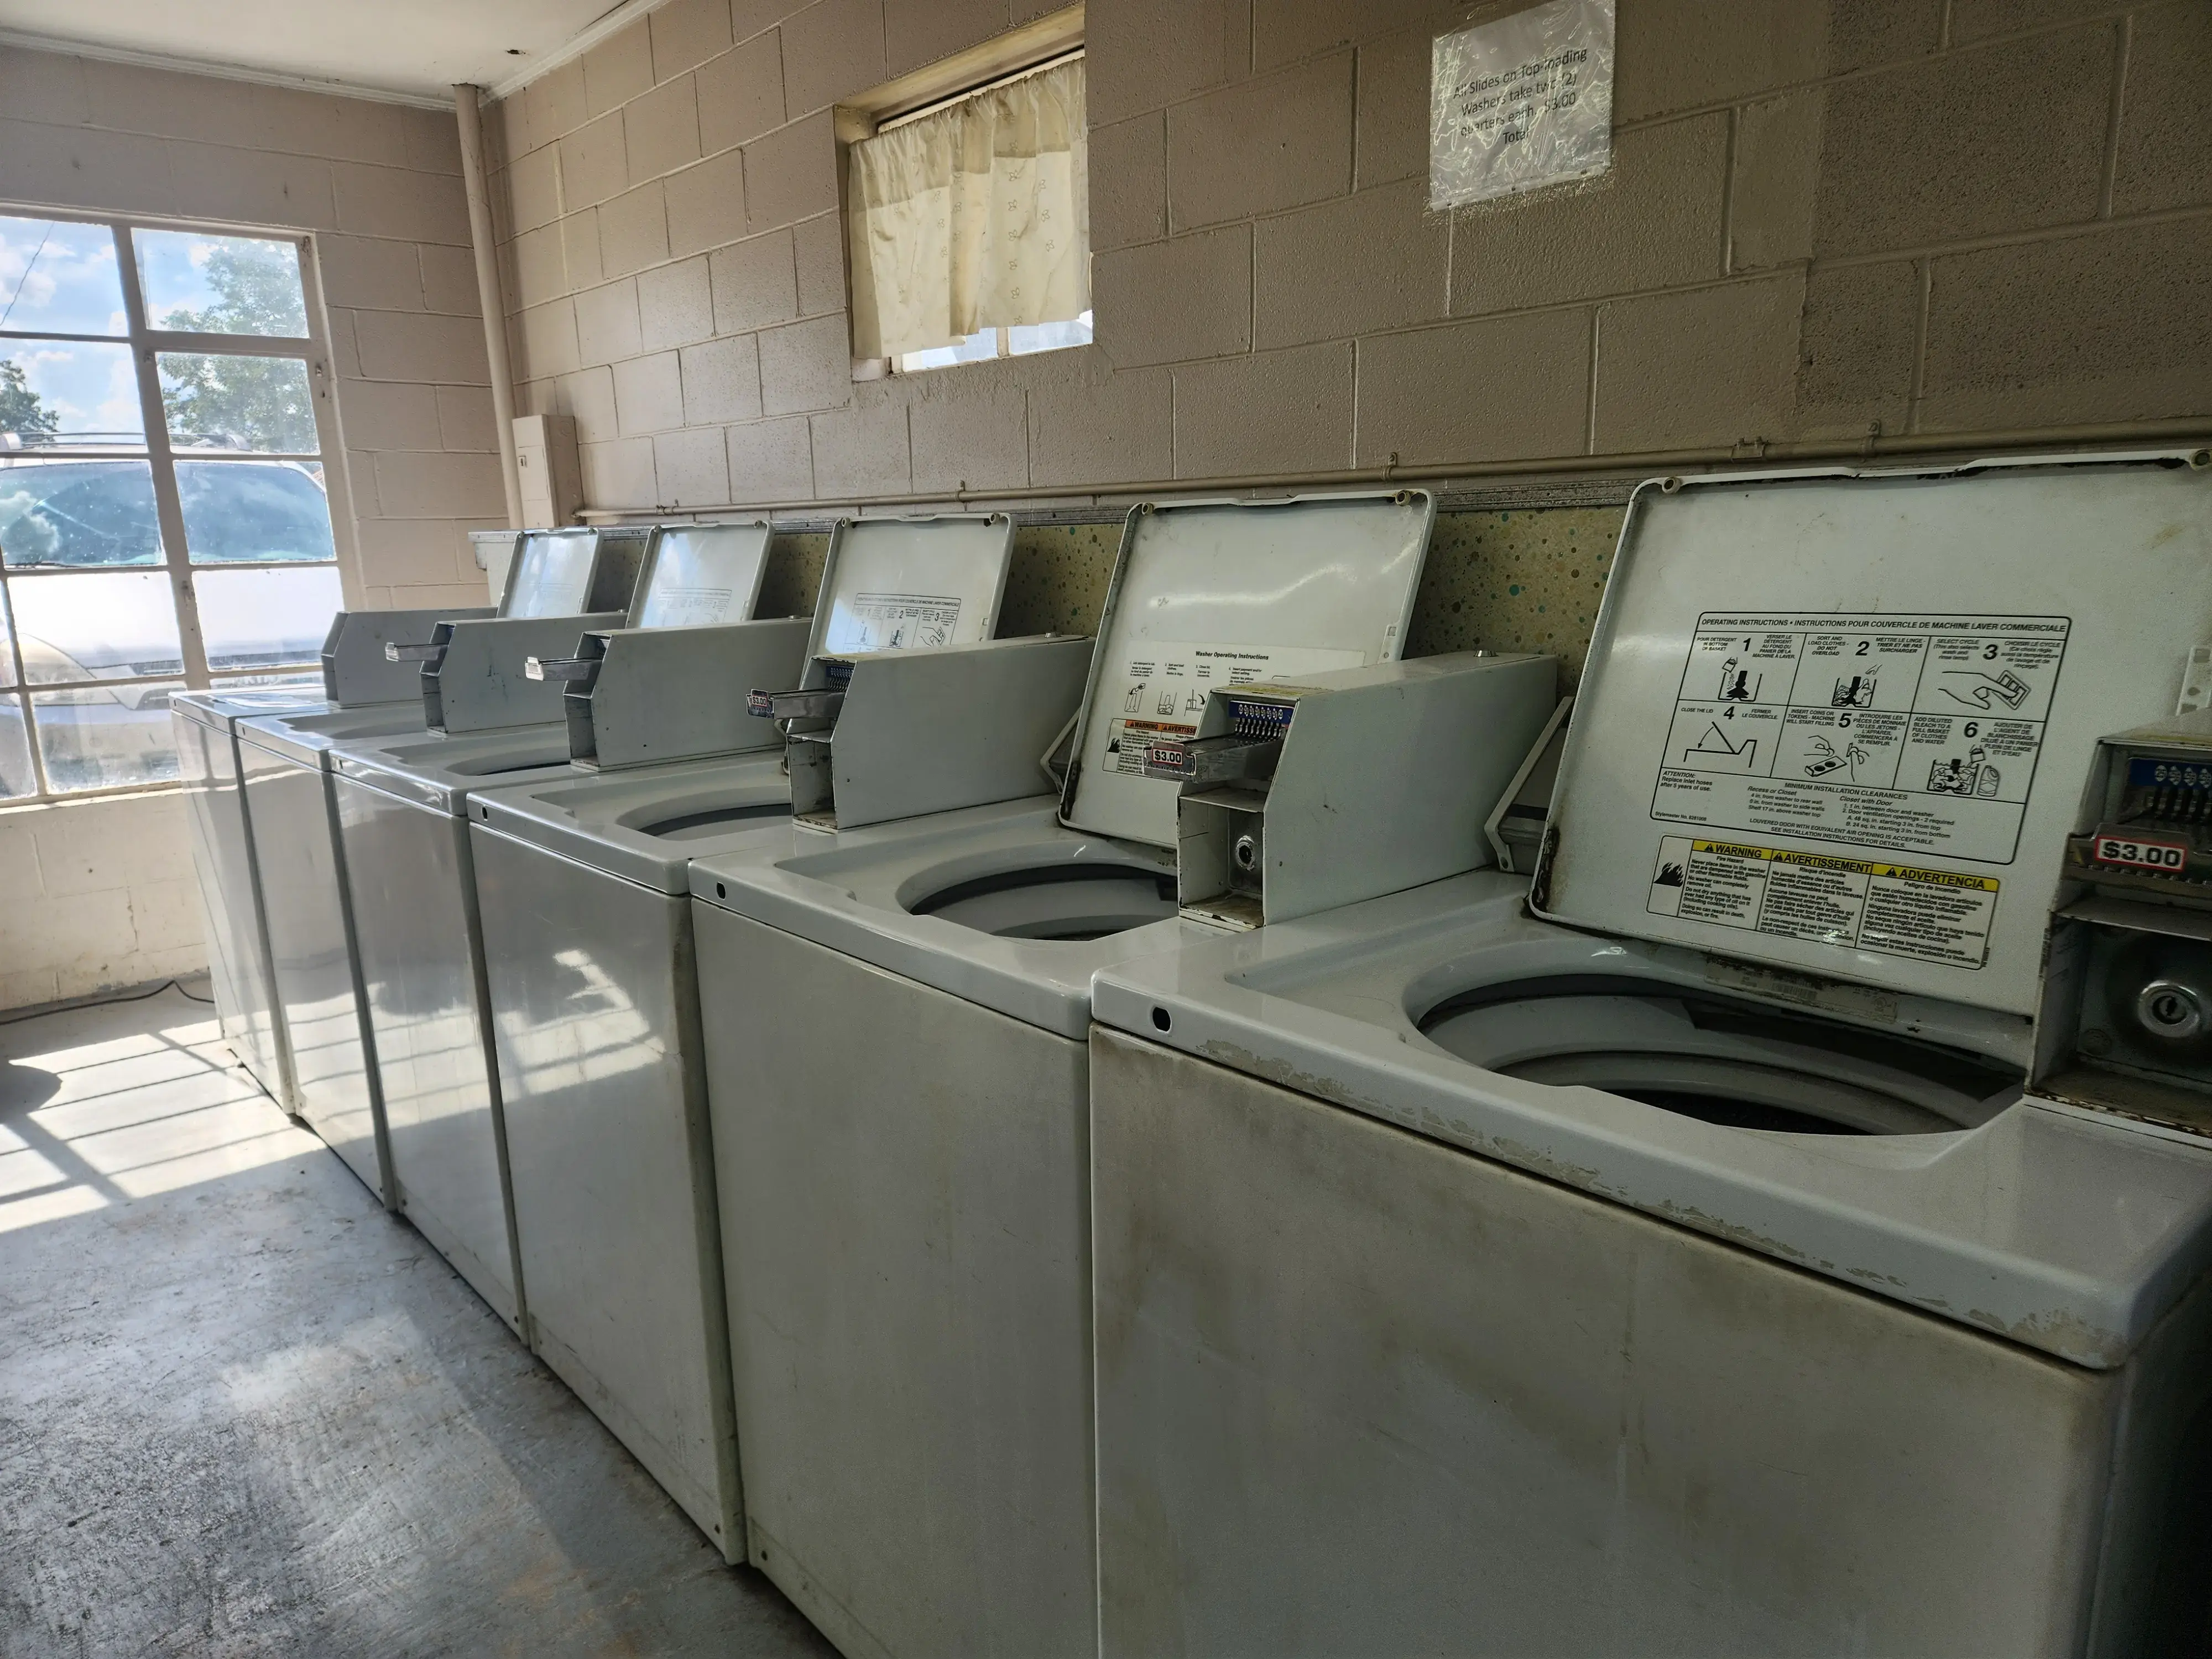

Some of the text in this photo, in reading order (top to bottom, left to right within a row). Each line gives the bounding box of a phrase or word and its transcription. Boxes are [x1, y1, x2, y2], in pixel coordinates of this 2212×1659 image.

[1469, 76, 1499, 94] Slides
[1503, 72, 1516, 83] on
[1521, 49, 1587, 78] Top-loading
[1462, 96, 1506, 116] Washers
[1509, 86, 1532, 102] take
[1461, 116, 1505, 137] quarters
[1545, 92, 1576, 113] $3.00
[1503, 126, 1529, 144] Total
[899, 610, 904, 619] 2
[935, 613, 940, 621] 3
[2000, 623, 2067, 632] COMMERCIALE
[1743, 638, 1751, 652] 1
[1855, 641, 1870, 656] 2
[1983, 644, 1998, 660] 3
[753, 697, 766, 705] $3.00
[1723, 706, 1735, 720] 4
[1135, 722, 1159, 730] WARNING
[1838, 713, 1852, 728] 5
[1167, 726, 1196, 734] AVERTISSE
[1964, 722, 1979, 738] 6
[1154, 750, 1181, 763] $3.00
[1662, 770, 1696, 779] ATTENTION:
[1813, 785, 1860, 795] INSTALLATION
[1860, 790, 1908, 800] CLEARANCES
[1782, 828, 1822, 837] INSTALLATION
[1822, 833, 1865, 843] INSTRUCTIONS
[1879, 840, 1906, 848] DETAILS.
[1811, 825, 1846, 834] EQUIVALENT
[1858, 831, 1885, 839] OPENING
[1716, 844, 1762, 858] WARNING
[2103, 841, 2181, 867] $3.00
[1783, 853, 1871, 873] AVERTISSEMENT
[1899, 869, 1985, 889] ADVERTENCIA
[1903, 881, 1926, 890] Peligro
[1860, 940, 1888, 948] ocasionar
